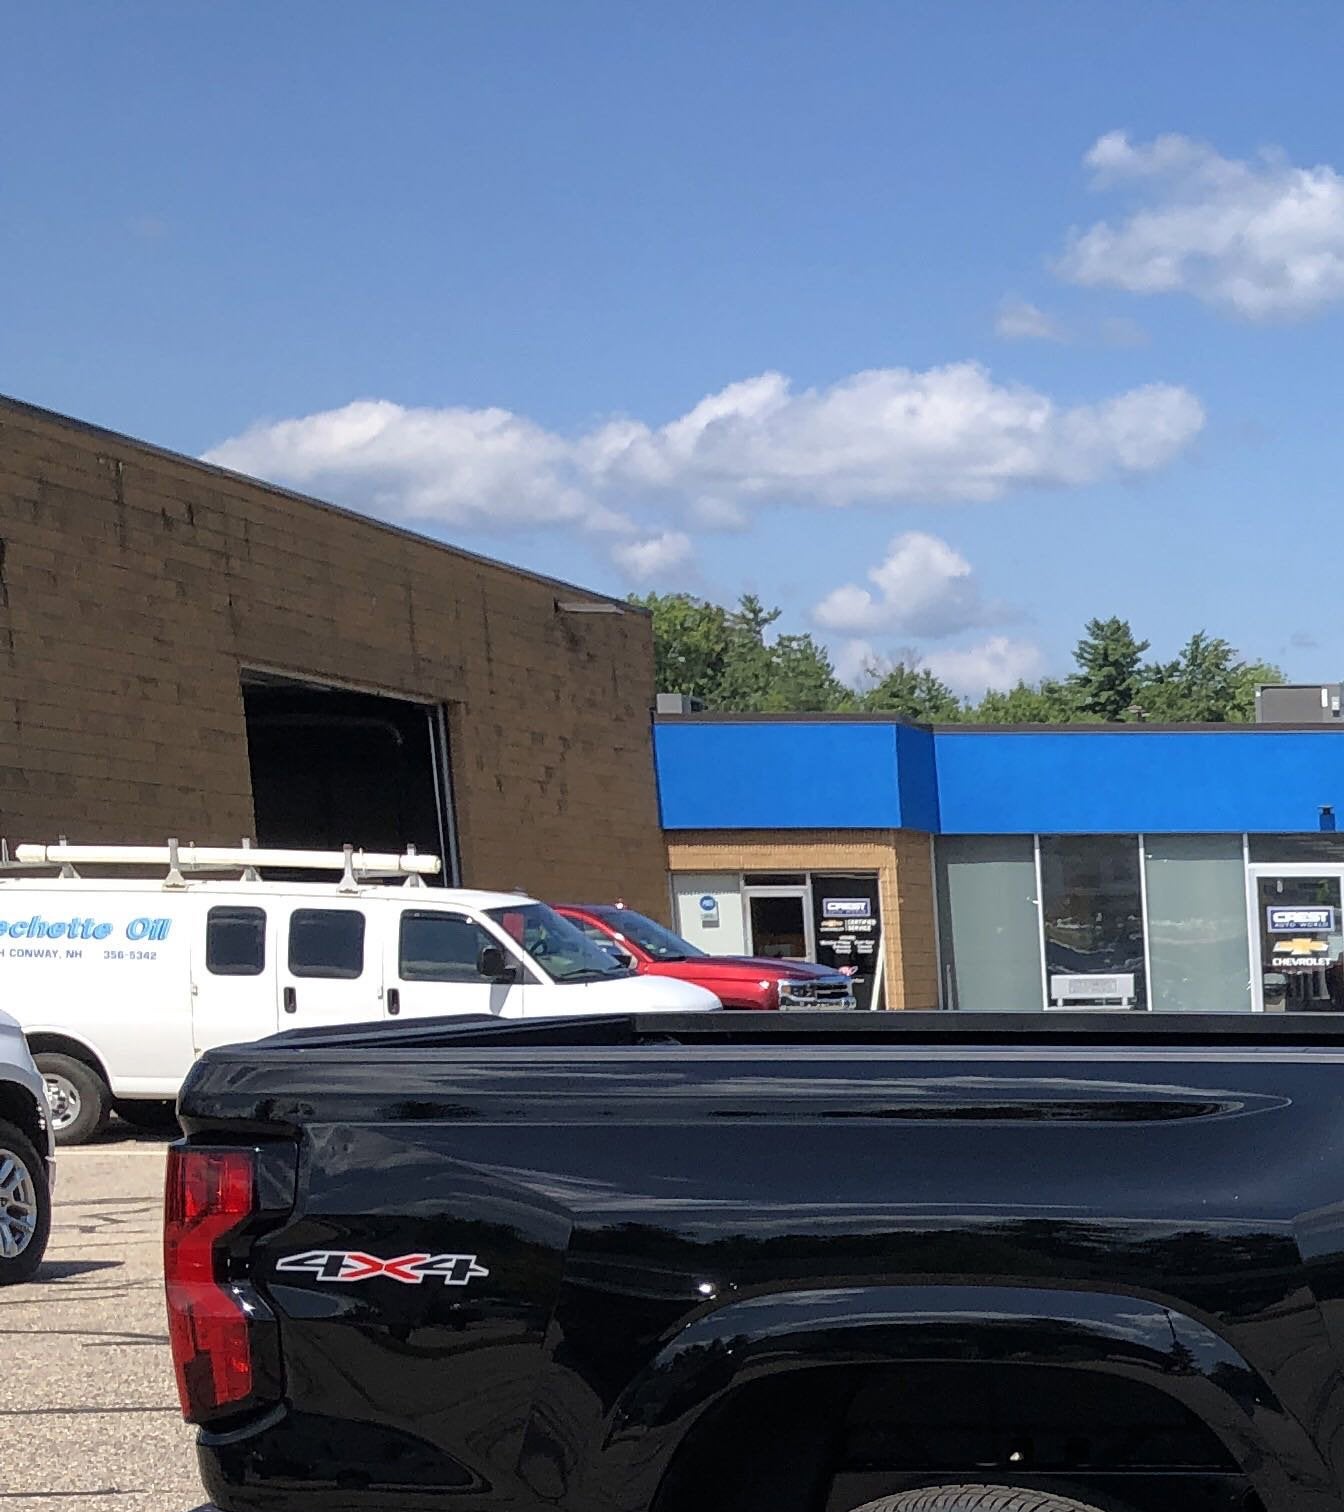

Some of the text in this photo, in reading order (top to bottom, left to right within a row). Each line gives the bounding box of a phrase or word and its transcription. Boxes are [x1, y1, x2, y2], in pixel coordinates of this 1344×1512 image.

[1272, 911, 1329, 923] CREST
[126, 917, 172, 941] Oil
[9, 948, 62, 960] CONWAY,
[65, 949, 82, 959] NH
[1272, 957, 1332, 967] CHEVROLET
